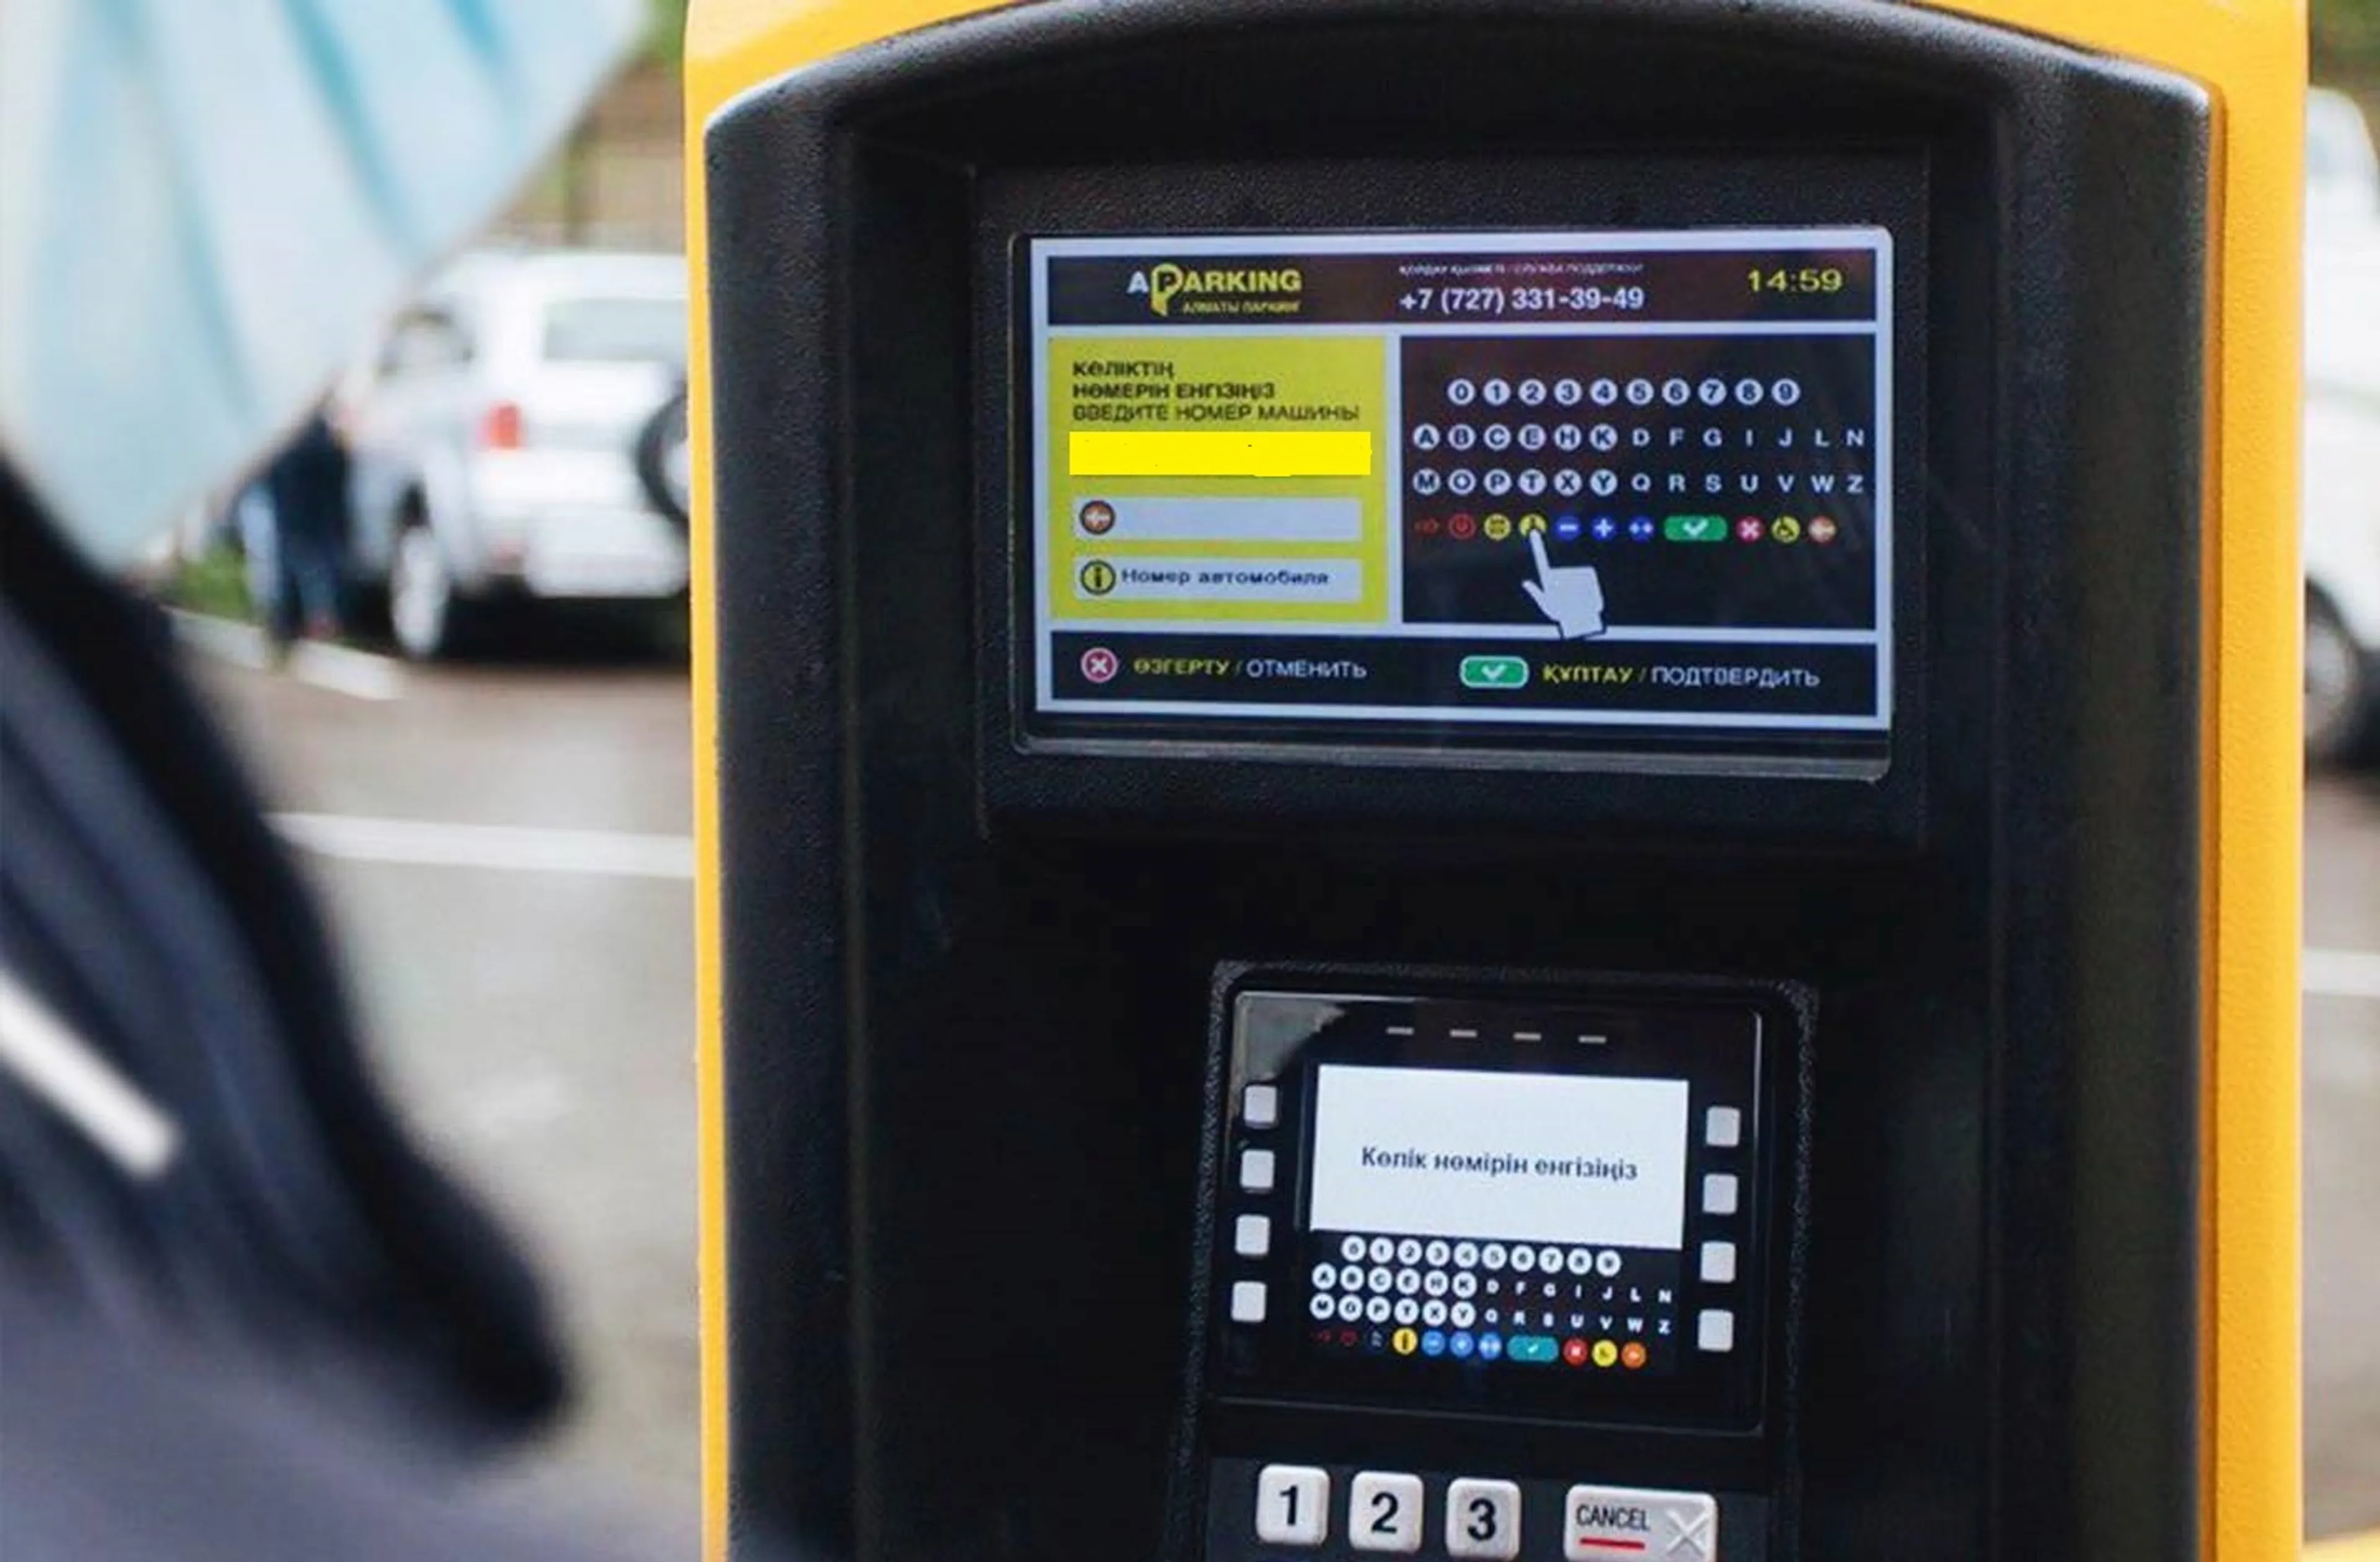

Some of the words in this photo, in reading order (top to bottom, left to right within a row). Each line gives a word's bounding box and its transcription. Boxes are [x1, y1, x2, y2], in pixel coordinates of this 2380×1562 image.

[1748, 269, 1843, 292] 14:59
[1400, 289, 1434, 309] +7
[1441, 288, 1505, 314] (727)
[1512, 288, 1644, 310] 331-39-49
[1073, 404, 1169, 423] ВВЕДИТЕ
[1176, 404, 1251, 421] НОМЕР
[1258, 404, 1360, 422] МАШИНЫ
[1121, 570, 1191, 586] Номер
[1198, 568, 1329, 585] автомобиля
[1134, 659, 1230, 677] ӨЗГЕРТУ
[1246, 659, 1368, 679] ОТМЕНИТЬ
[1651, 666, 1821, 689] ПОДТВЕРДИТЬ
[1278, 1485, 1298, 1527] 1
[1370, 1491, 1398, 1534] 2
[1576, 1504, 1650, 1532] CANCEL
[1466, 1498, 1497, 1542] 3
